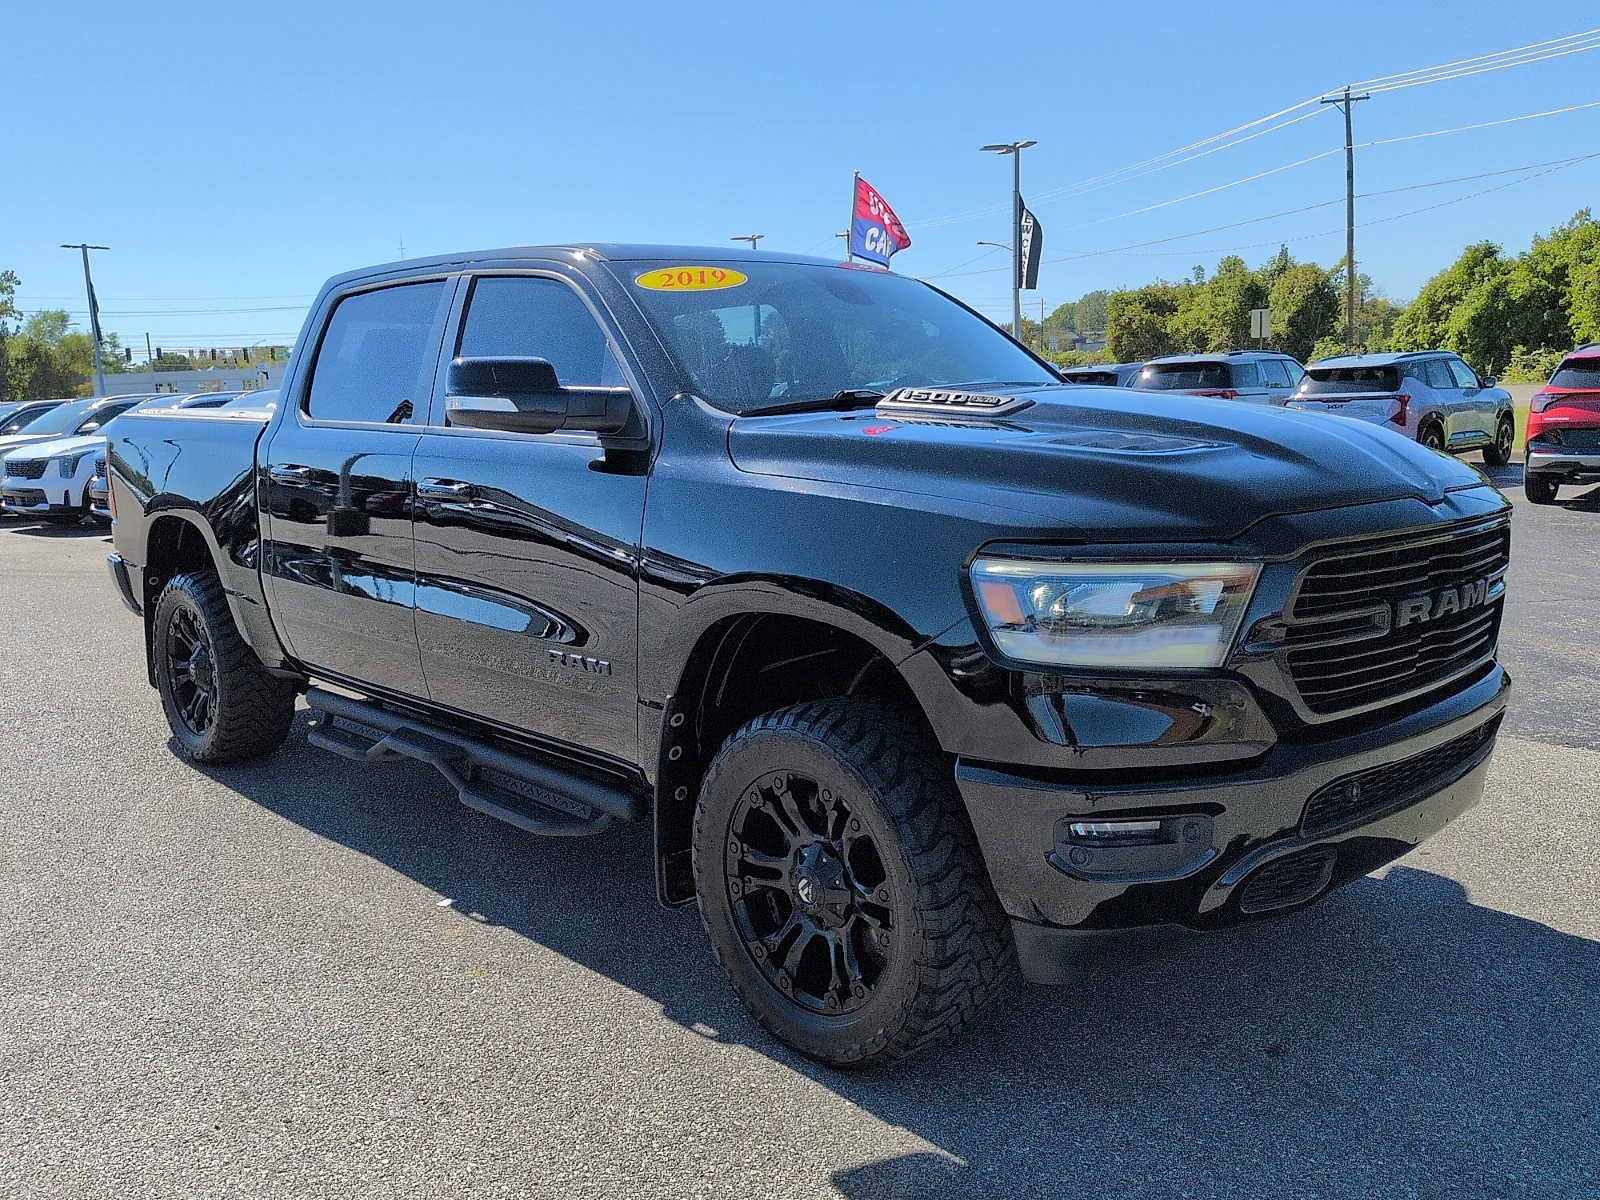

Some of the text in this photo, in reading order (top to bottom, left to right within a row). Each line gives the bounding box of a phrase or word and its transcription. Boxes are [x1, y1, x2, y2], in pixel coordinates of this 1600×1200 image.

[659, 269, 727, 288] 2019
[902, 390, 968, 403] 1500
[1396, 579, 1486, 629] RAM
[546, 649, 612, 677] RAM
